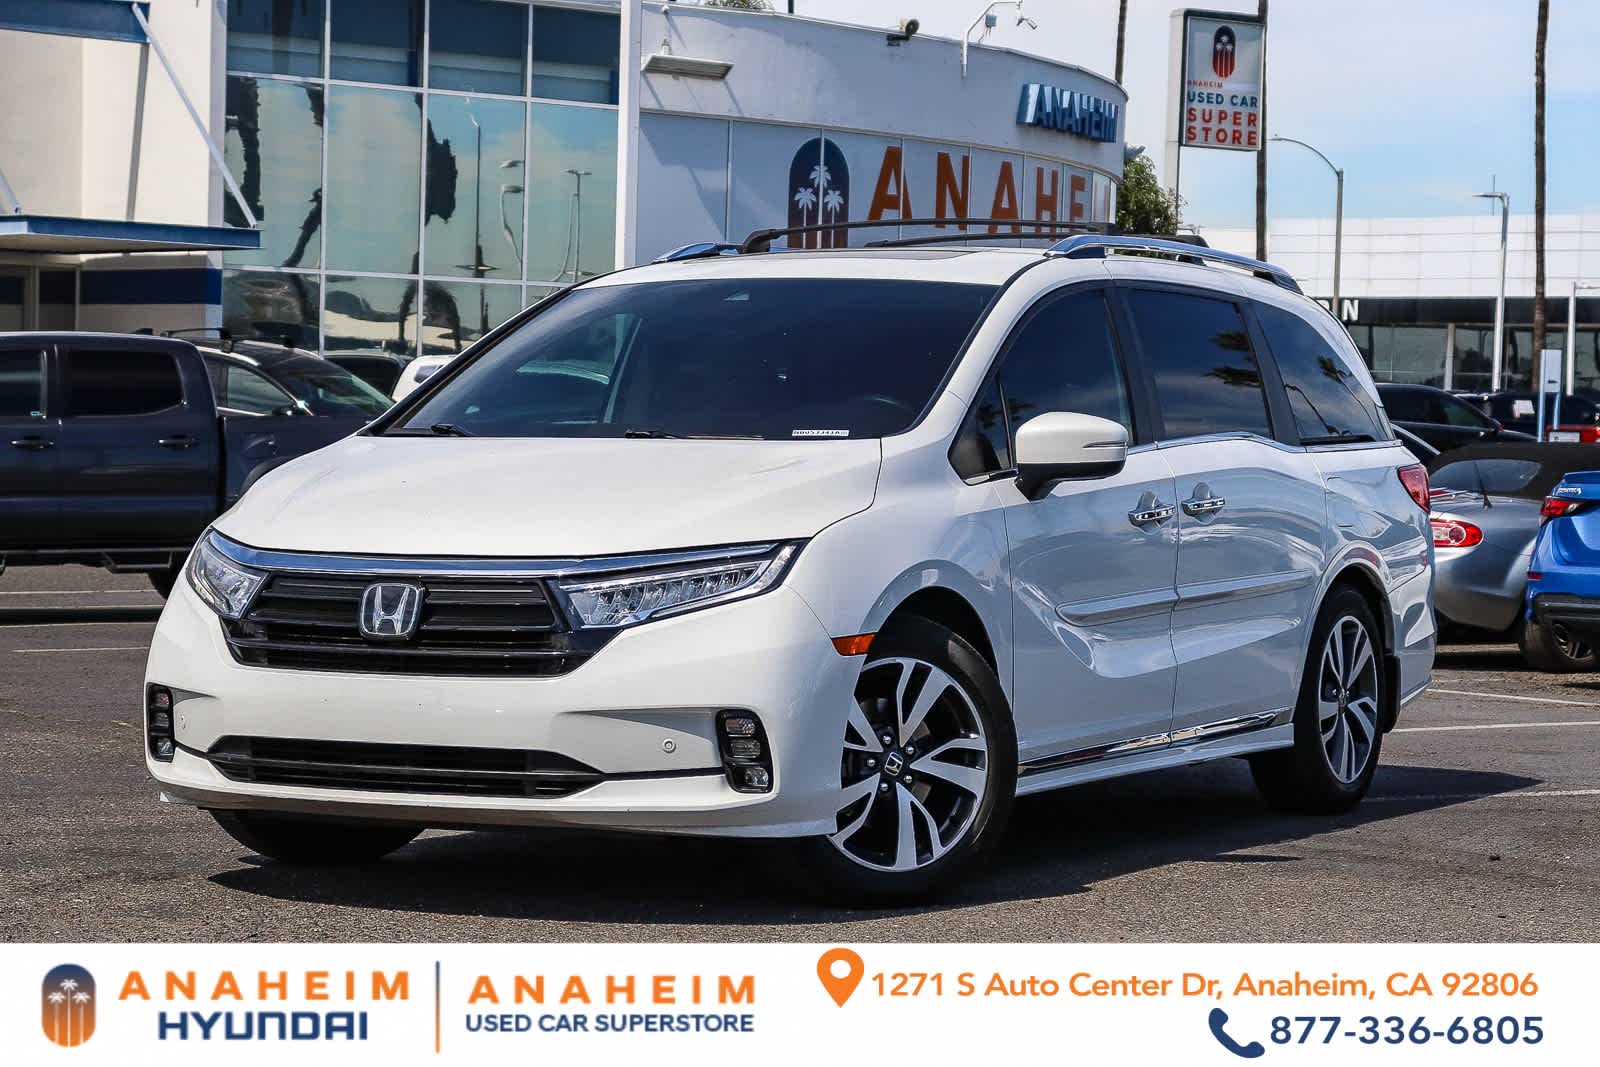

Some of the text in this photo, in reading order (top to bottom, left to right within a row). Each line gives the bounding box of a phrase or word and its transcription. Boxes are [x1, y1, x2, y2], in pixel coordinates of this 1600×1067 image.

[1187, 91, 1258, 108] USED CAR
[1188, 107, 1257, 127] SUPER
[1187, 125, 1257, 146] STORE
